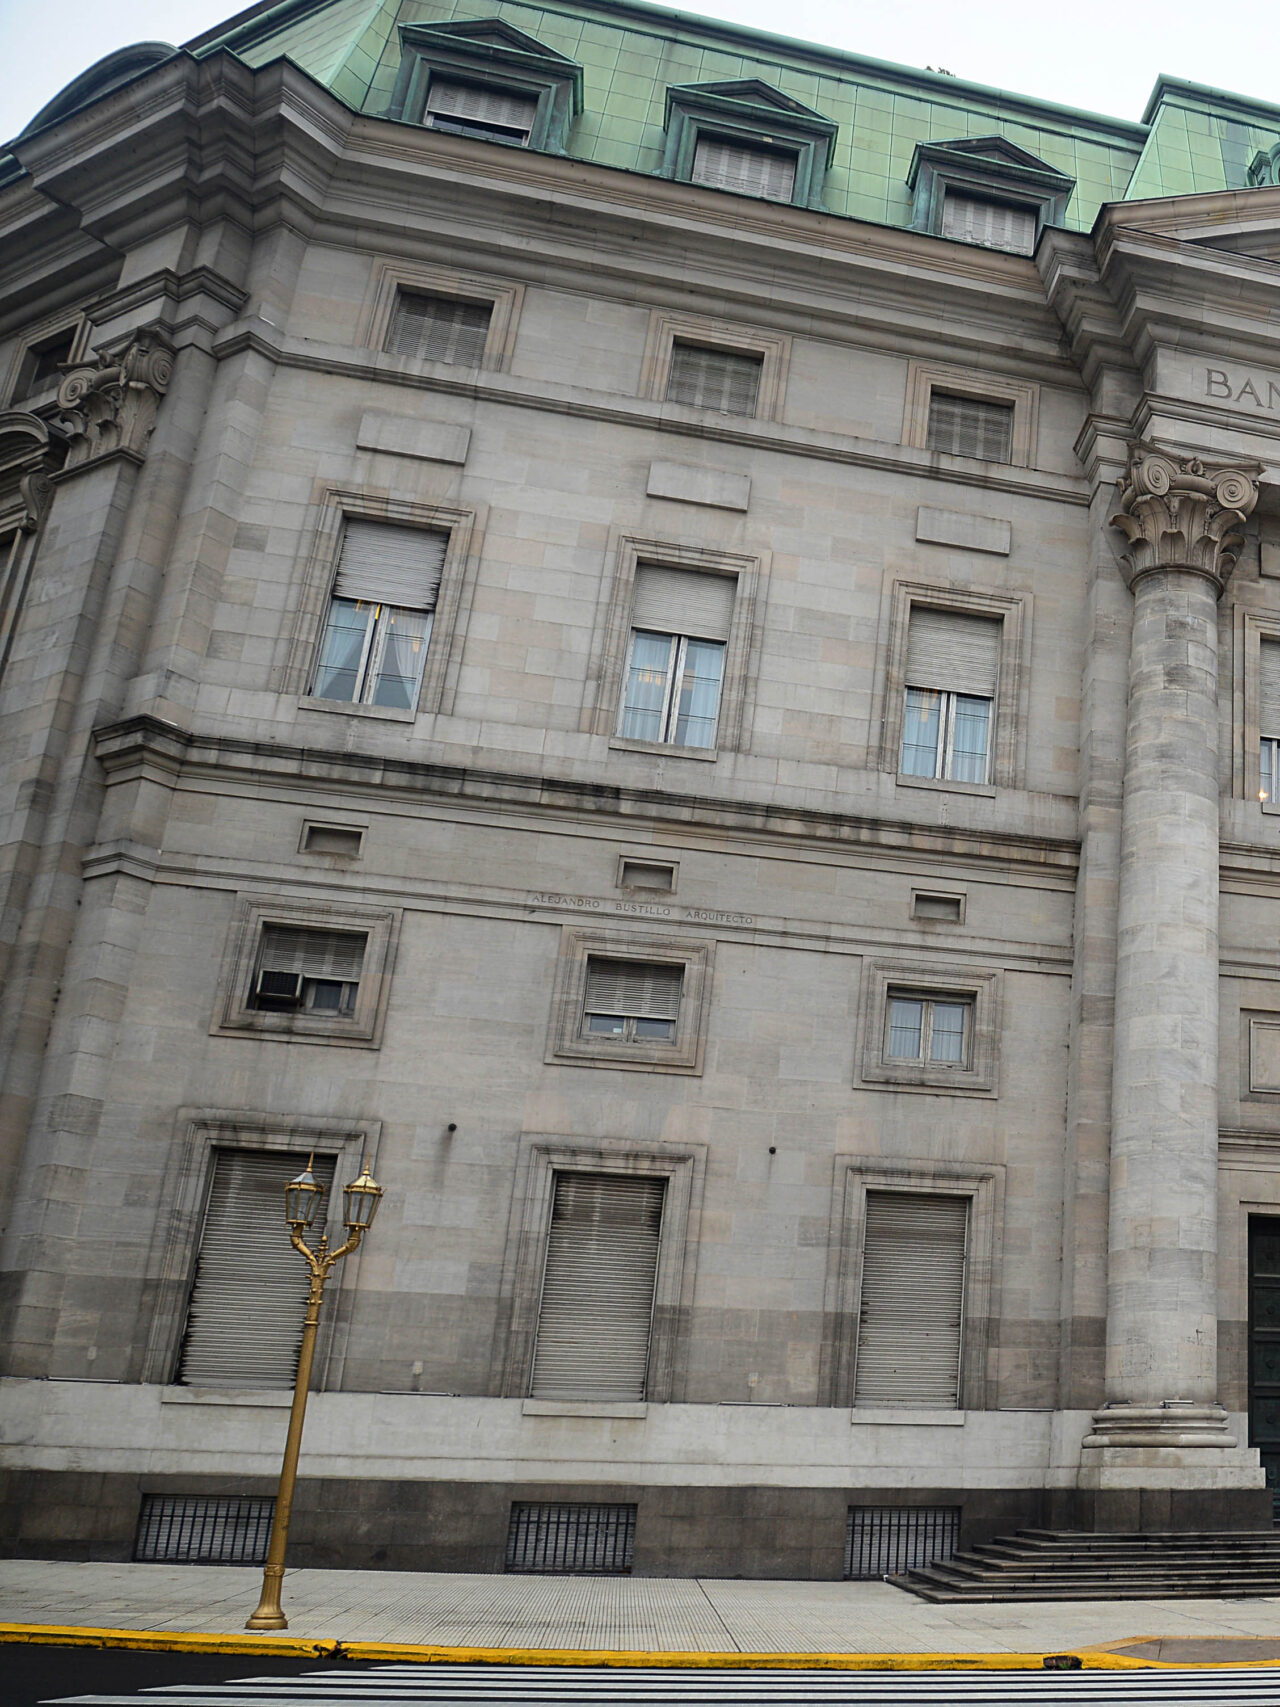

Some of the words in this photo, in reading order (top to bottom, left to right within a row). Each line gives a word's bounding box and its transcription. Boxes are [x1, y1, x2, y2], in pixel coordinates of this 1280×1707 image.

[532, 894, 600, 908] ALEJANDRO
[615, 902, 671, 916] BUSTILLO
[686, 911, 753, 925] ARQUITECTO
